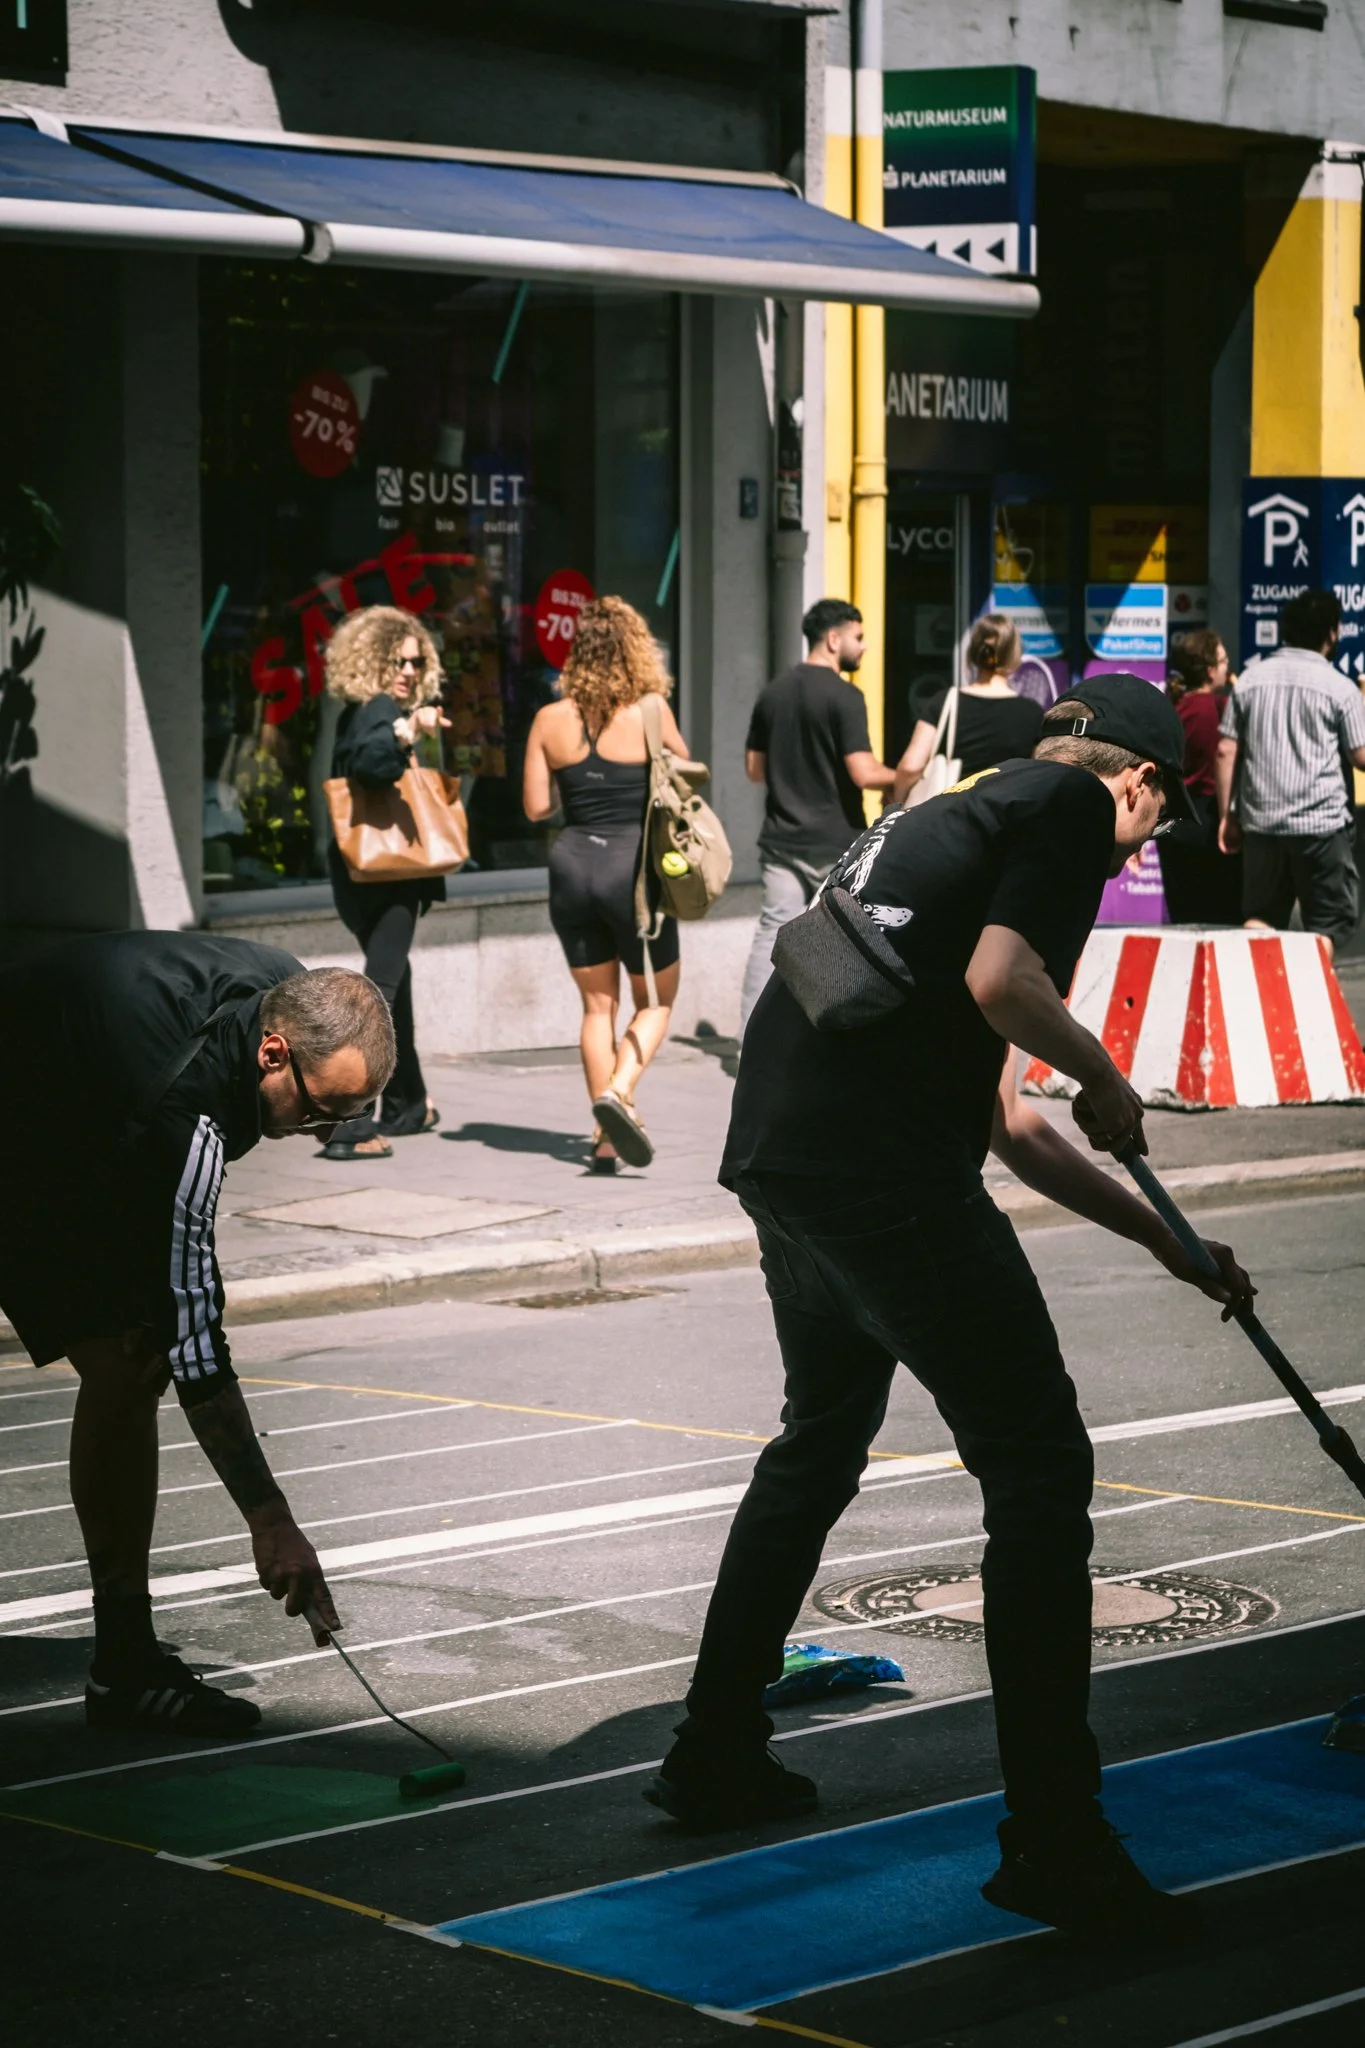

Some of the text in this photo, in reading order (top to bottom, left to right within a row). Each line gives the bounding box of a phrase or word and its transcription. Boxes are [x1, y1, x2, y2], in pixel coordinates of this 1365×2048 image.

[884, 106, 1007, 129] NATURMUSEUM
[901, 168, 1007, 188] PLANETARIUM
[886, 373, 1008, 424] ANETARIUM
[409, 472, 525, 507] SUSLET
[435, 517, 455, 532] bio
[1108, 611, 1161, 627] Hermes
[1102, 638, 1161, 653] PaketShop
